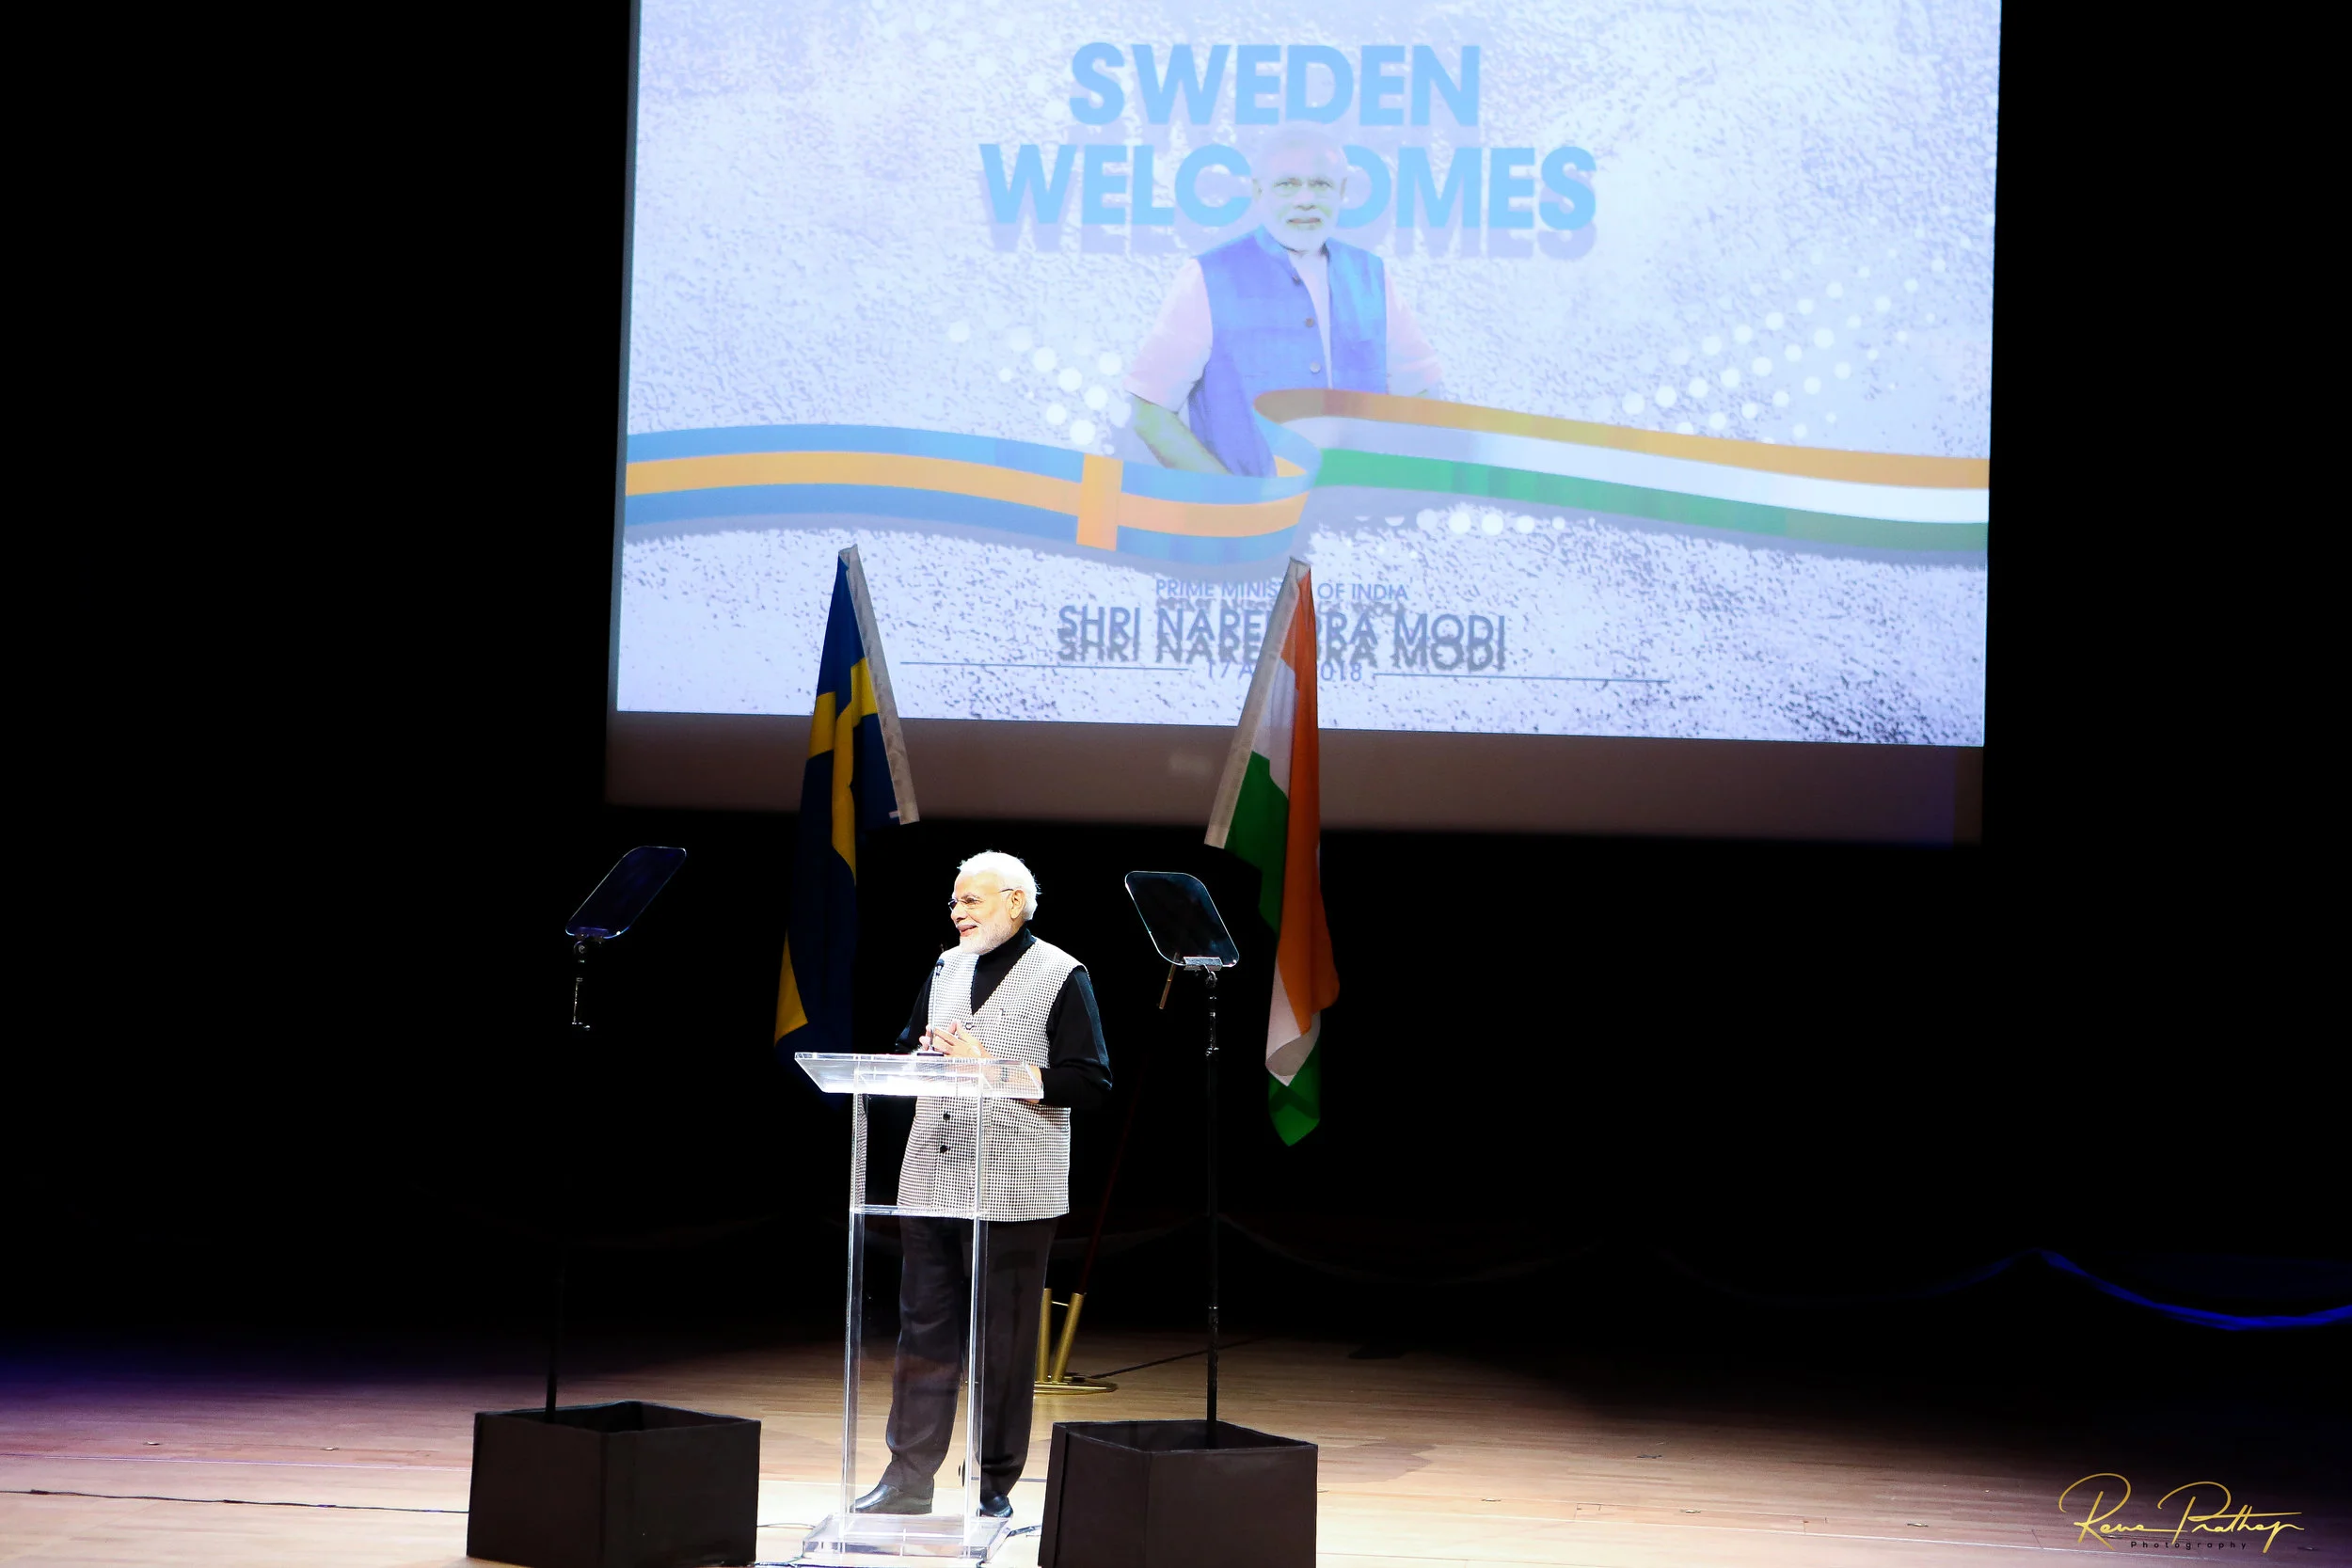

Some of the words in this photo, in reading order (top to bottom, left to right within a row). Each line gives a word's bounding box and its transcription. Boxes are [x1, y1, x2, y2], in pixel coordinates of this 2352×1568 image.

[1069, 41, 1480, 126] SWEDEN
[1156, 578, 1215, 597] PRIME
[1222, 580, 1281, 599] MINIS
[1317, 582, 1345, 600] OF
[1352, 583, 1408, 601] INDIA
[1058, 605, 1140, 641] SHRI
[1156, 608, 1377, 645] NARERA
[1394, 612, 1505, 648] MODI
[1320, 661, 1361, 682] 018
